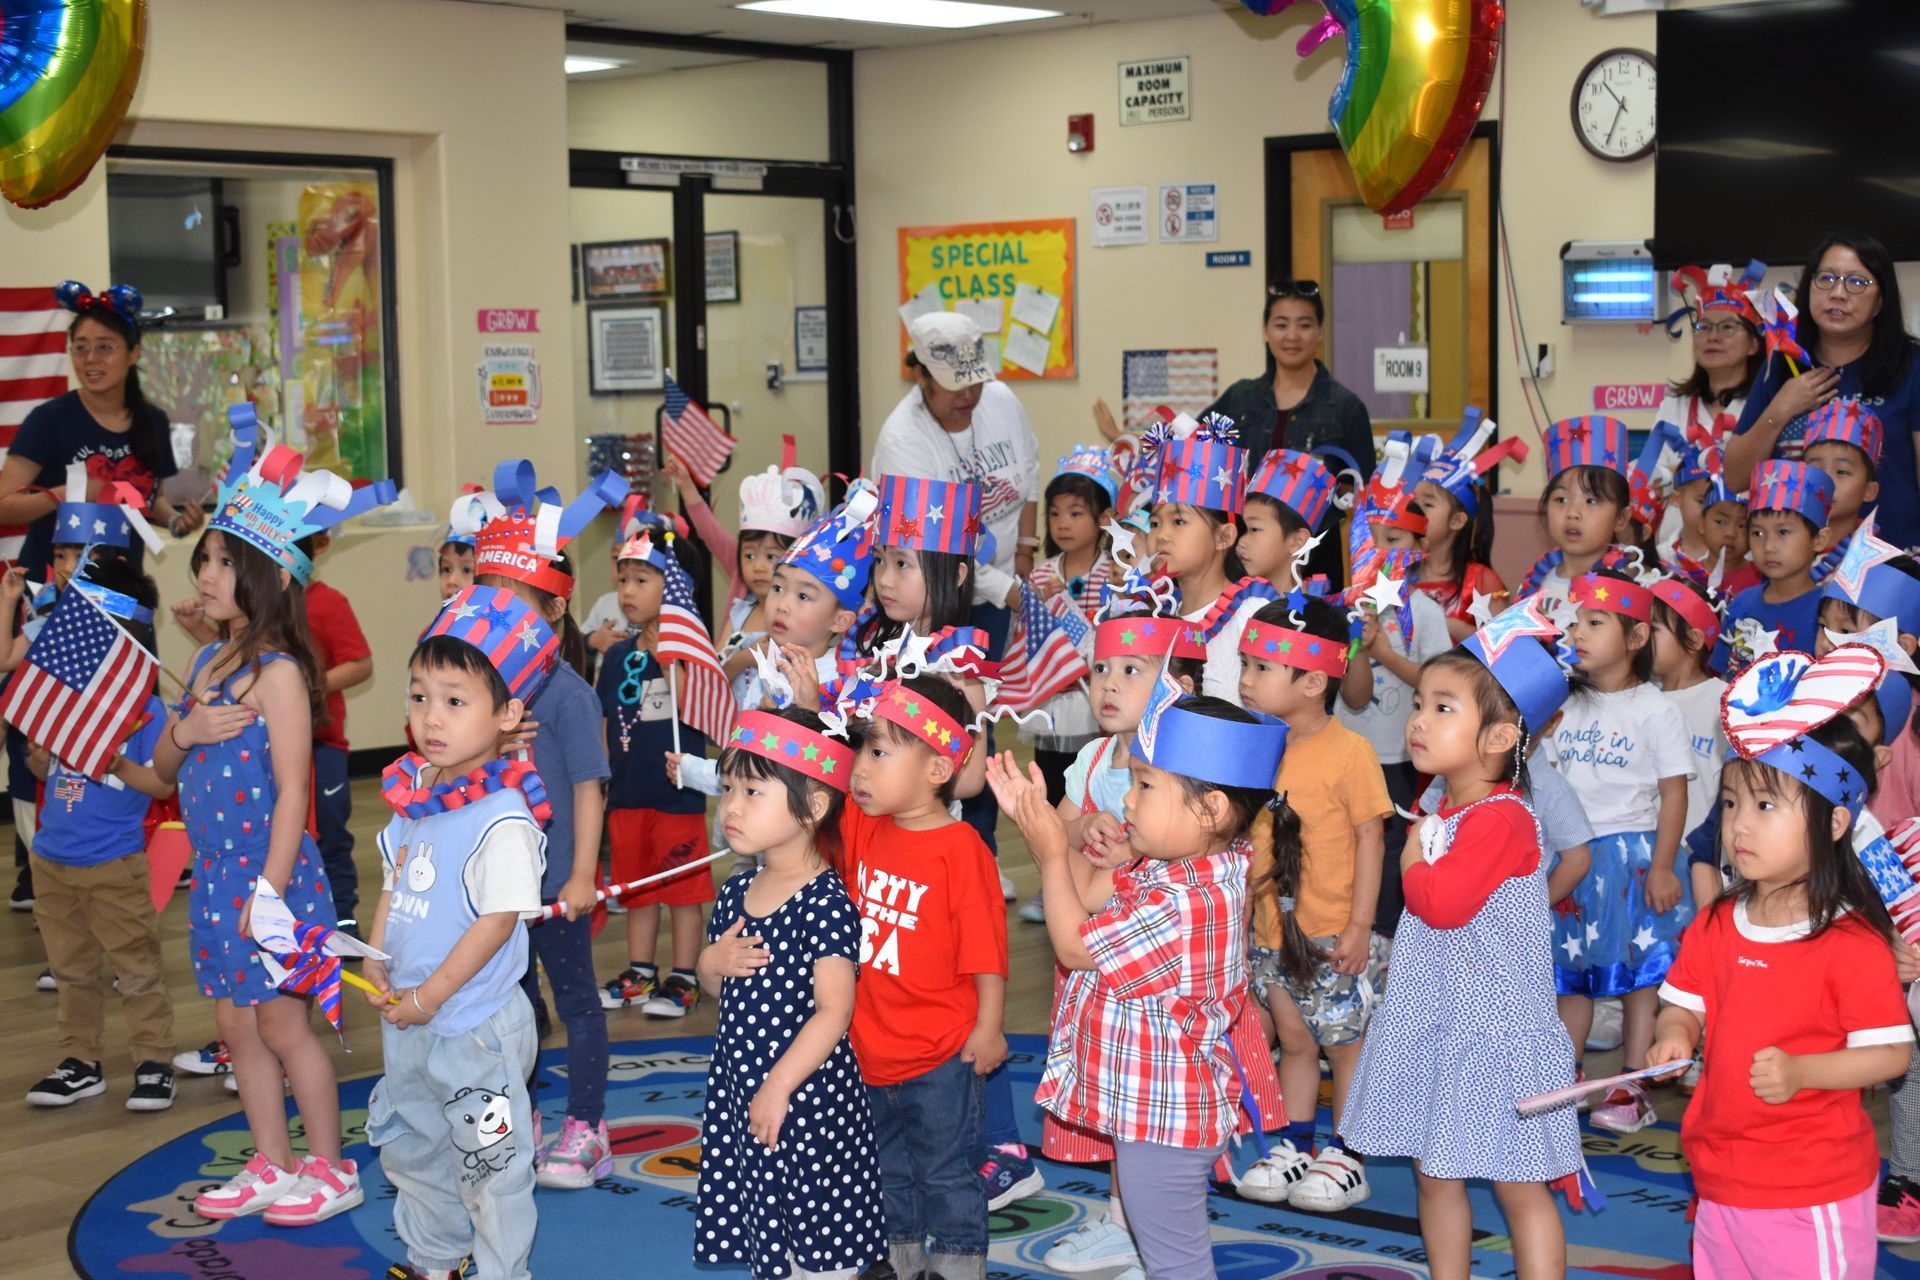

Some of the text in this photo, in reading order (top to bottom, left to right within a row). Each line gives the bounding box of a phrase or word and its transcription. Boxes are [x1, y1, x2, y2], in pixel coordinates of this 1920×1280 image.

[1126, 62, 1182, 78] MAXIMUM
[1603, 68, 1612, 81] 11
[1619, 61, 1630, 74] 12
[1137, 78, 1170, 92] ROOM
[1592, 83, 1602, 96] 10
[1125, 92, 1183, 108] CAPACITY
[1148, 106, 1184, 118] PERSONS
[931, 240, 1029, 270] SPECIAL
[1212, 255, 1237, 264] ROOM
[939, 272, 1017, 300] CLASS
[487, 310, 530, 333] GROW
[1385, 360, 1422, 378] ROOM 9
[1605, 385, 1656, 409] GROW
[252, 502, 285, 528] Happy
[255, 522, 282, 542] JULY
[477, 550, 538, 574] AMERICA
[1558, 719, 1634, 752] made in
[1559, 745, 1630, 769] america
[865, 901, 919, 931] THE
[859, 916, 900, 977] SA
[1580, 1140, 1684, 1161] ello
[1256, 1222, 1369, 1248] seven
